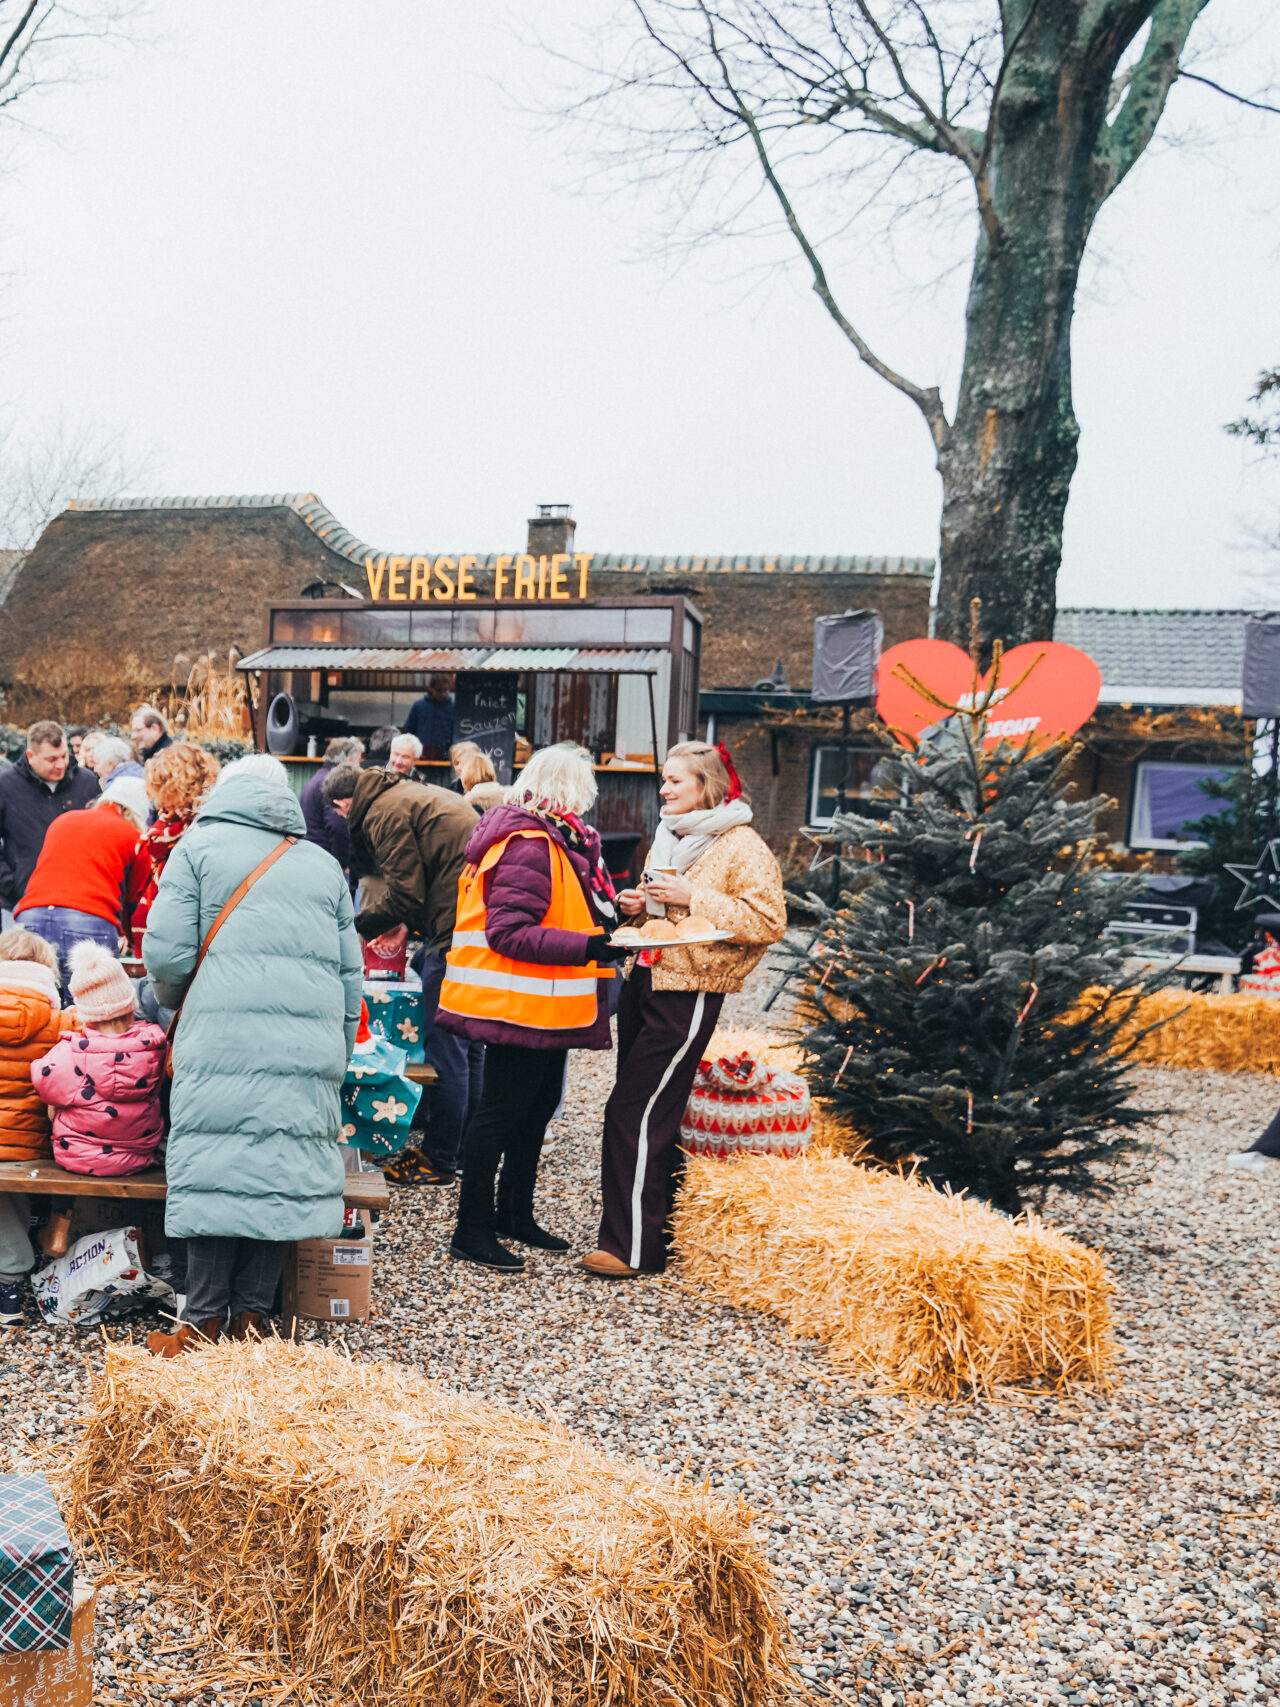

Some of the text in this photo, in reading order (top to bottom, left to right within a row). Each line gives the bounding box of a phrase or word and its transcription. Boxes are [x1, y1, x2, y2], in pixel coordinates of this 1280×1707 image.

[366, 554, 594, 600] VERSE FRIET
[69, 1240, 106, 1274] ACTION
